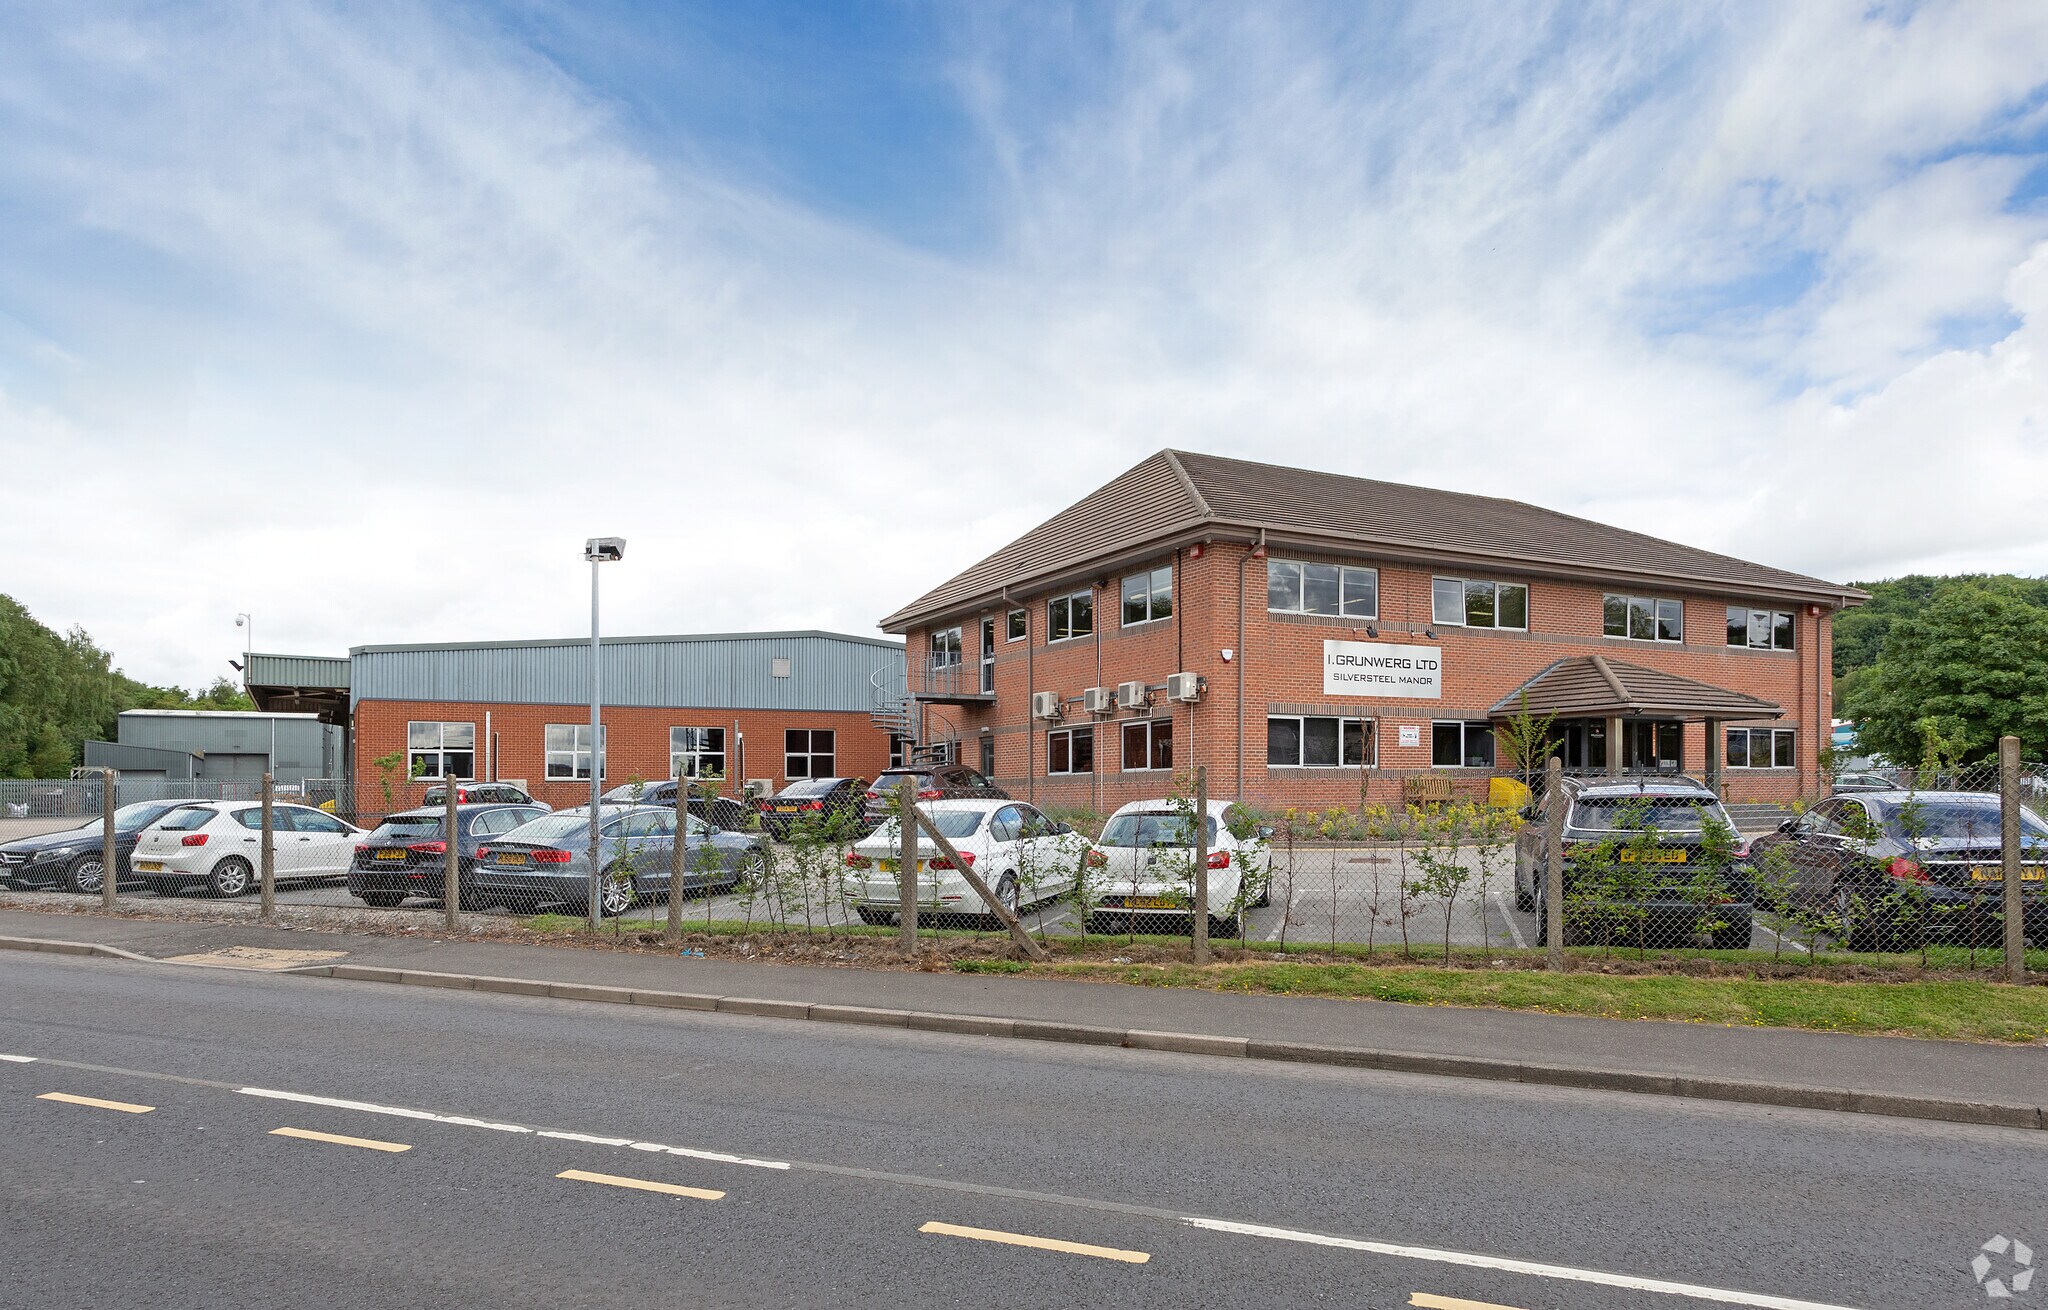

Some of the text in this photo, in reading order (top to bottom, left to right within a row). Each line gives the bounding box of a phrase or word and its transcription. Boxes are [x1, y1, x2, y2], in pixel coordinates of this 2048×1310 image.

[1327, 654, 1438, 670] I.GRUNWERG LTD
[1333, 673, 1433, 685] SILVERSTEEL MANOR
